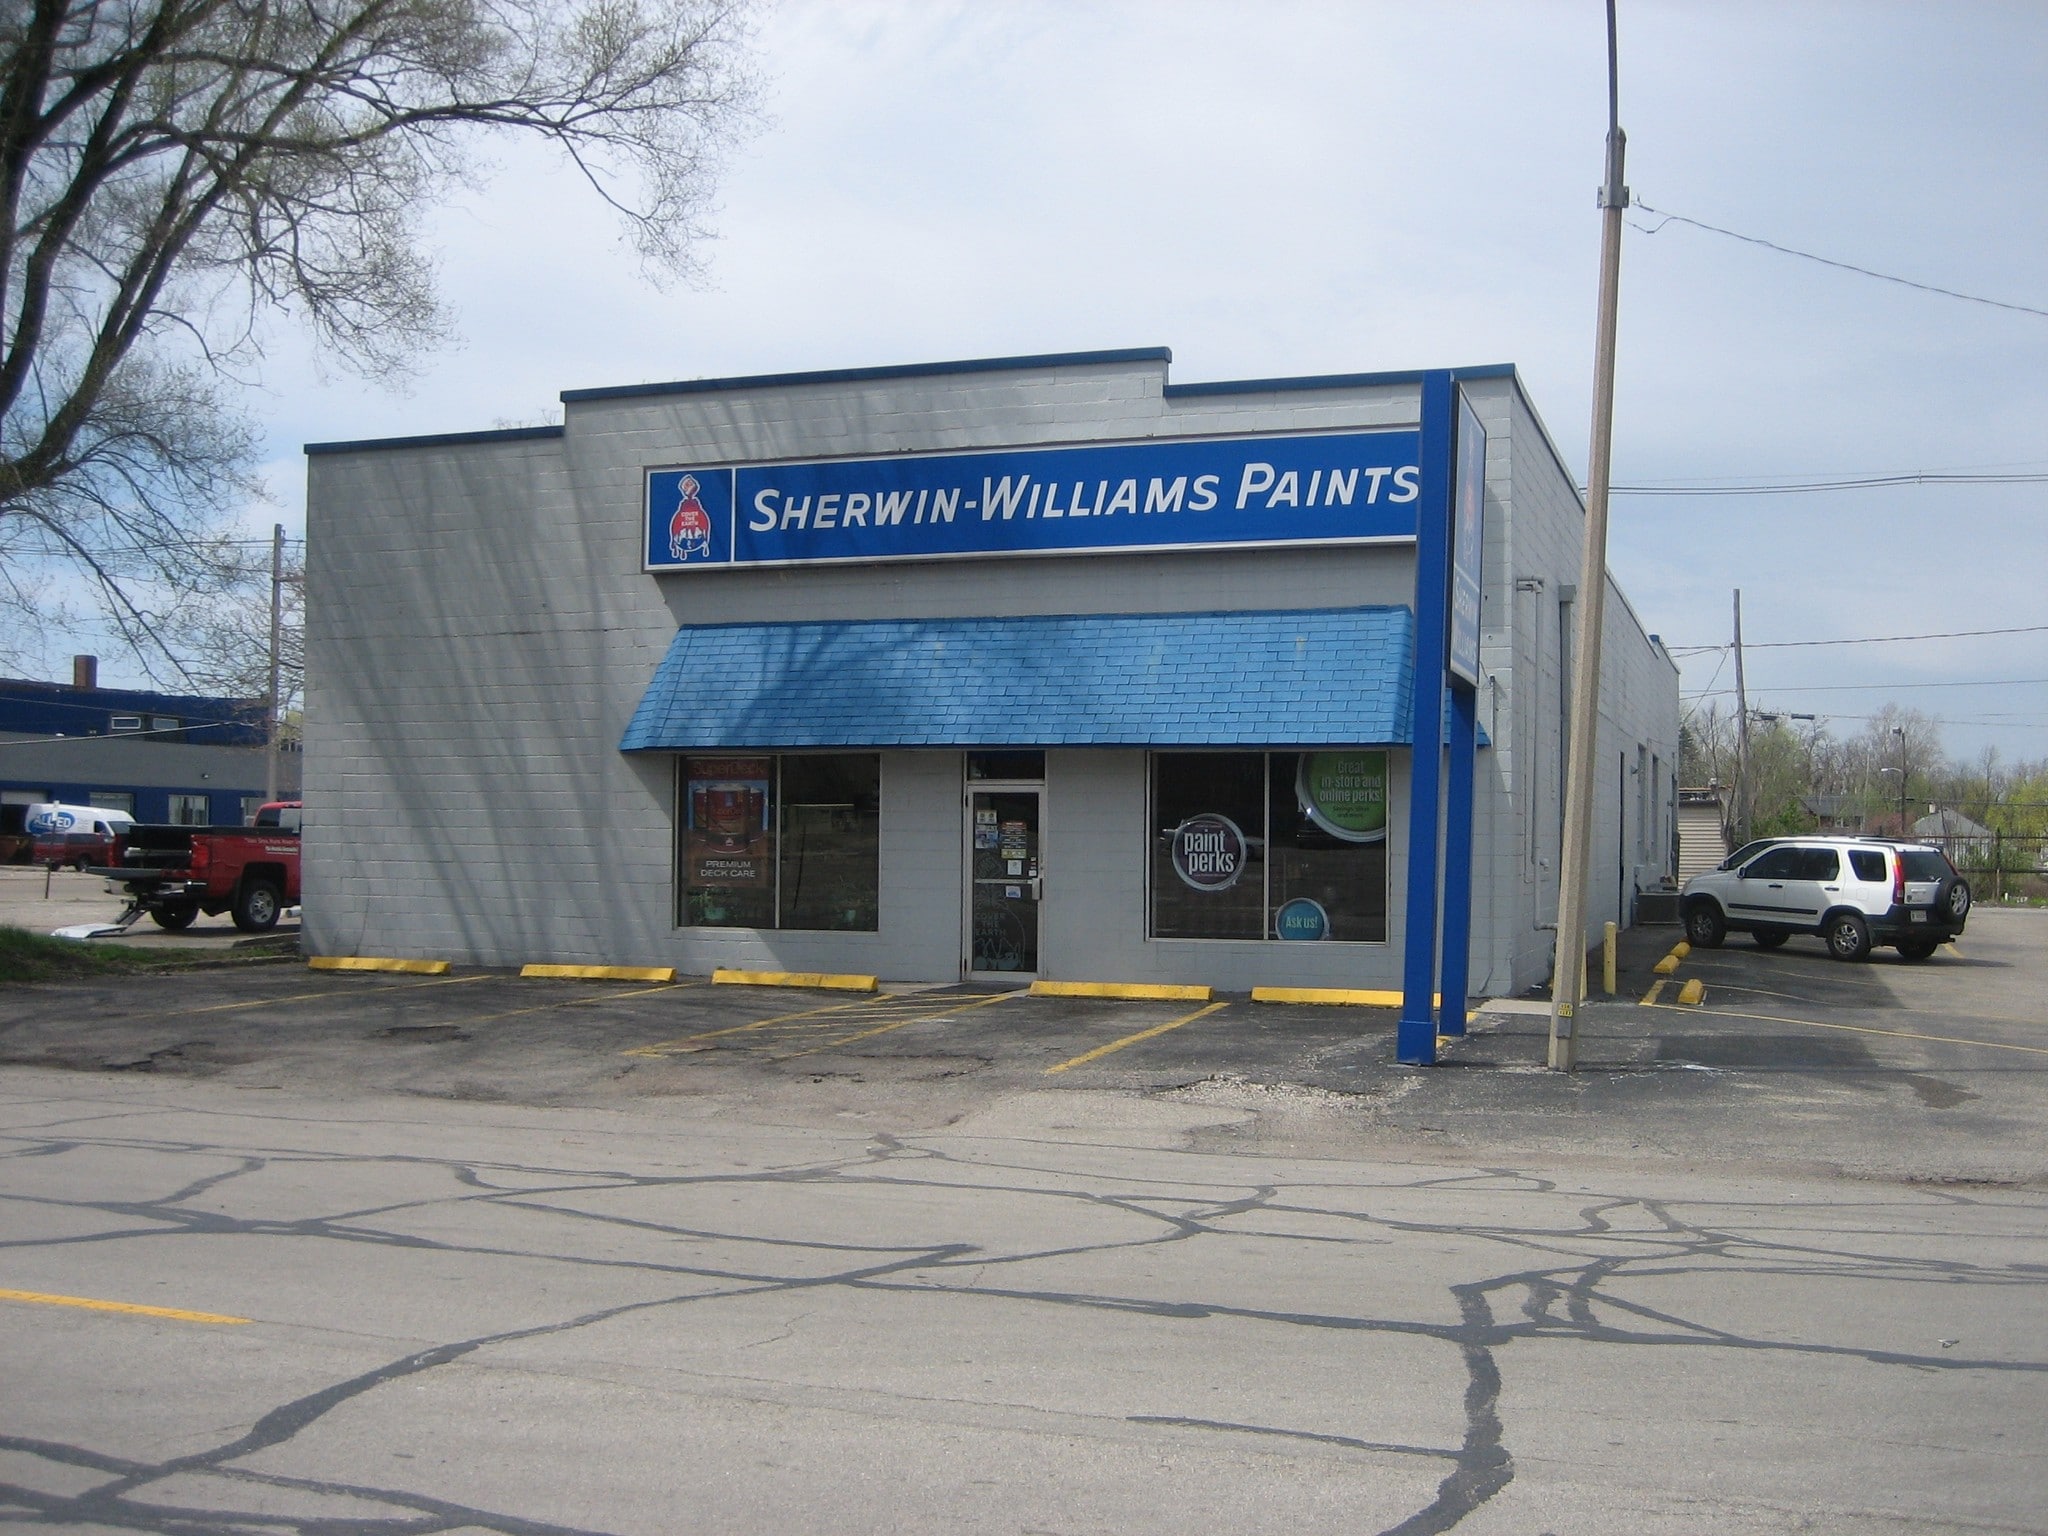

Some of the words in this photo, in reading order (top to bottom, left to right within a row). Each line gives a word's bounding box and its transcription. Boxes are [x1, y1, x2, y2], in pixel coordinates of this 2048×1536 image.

[749, 474, 1220, 532] SHERWIN-WILLIAMS
[1235, 462, 1419, 509] PAINTS
[1338, 760, 1364, 774] Great
[1362, 775, 1382, 788] and
[1320, 788, 1351, 802] online
[1352, 788, 1383, 803] perks!
[33, 813, 72, 828] ALLED
[1184, 829, 1226, 855] paint
[705, 860, 752, 868] PREMIUM
[1188, 849, 1234, 876] perks
[700, 869, 728, 877] DECK
[730, 869, 756, 878] CARE
[1286, 916, 1302, 928] Ask
[1304, 916, 1318, 928] us!
